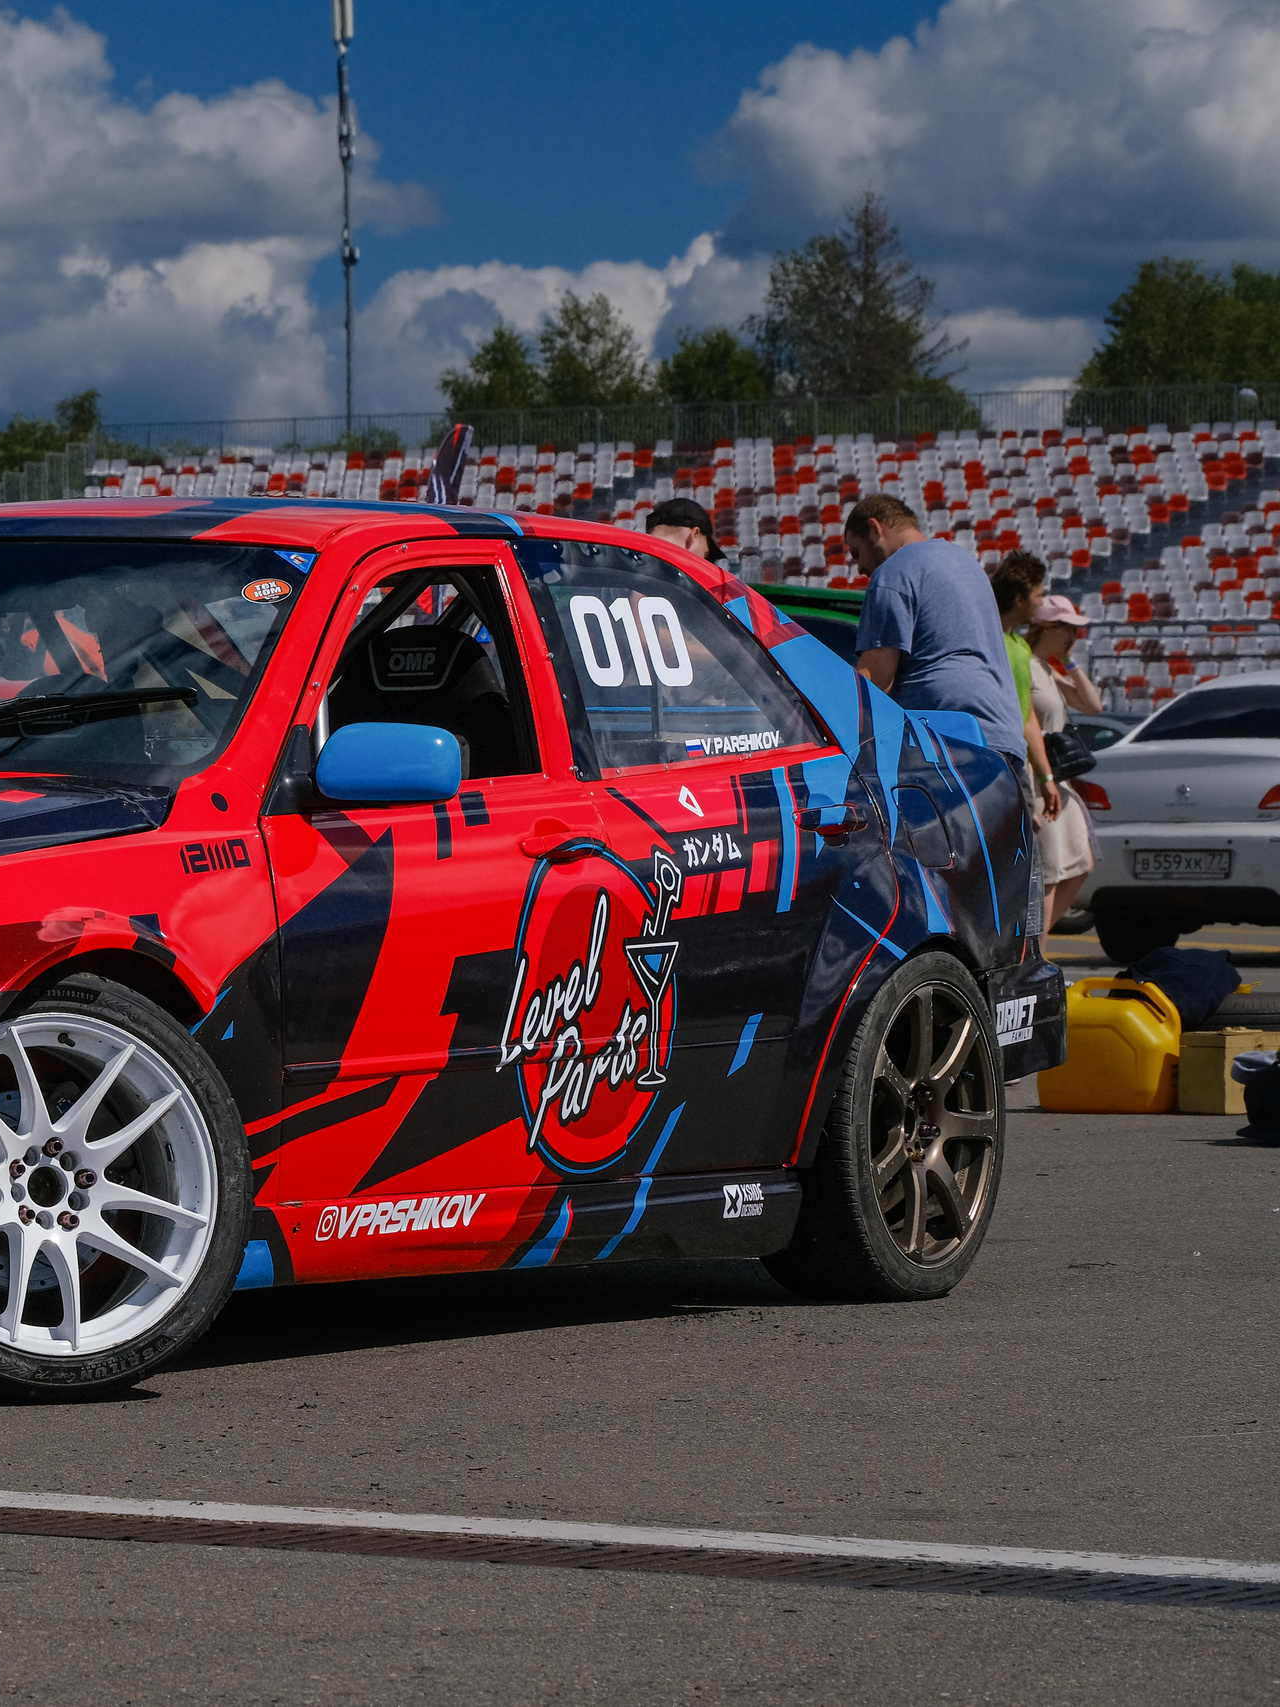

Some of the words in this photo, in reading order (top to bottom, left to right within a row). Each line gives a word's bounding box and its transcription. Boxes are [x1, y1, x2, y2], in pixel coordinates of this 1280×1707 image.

[569, 595, 694, 687] 010
[389, 652, 436, 671] OMP
[701, 730, 779, 755] V.PARSHIKOV
[682, 832, 742, 868] ガンダム
[495, 893, 608, 1073] Level
[995, 995, 1037, 1035] DRIFT
[529, 1004, 647, 1149] Parts
[740, 1183, 764, 1201] XSIDE
[740, 1203, 763, 1217] DESIGNS
[80, 1346, 154, 1381] SAILUN
